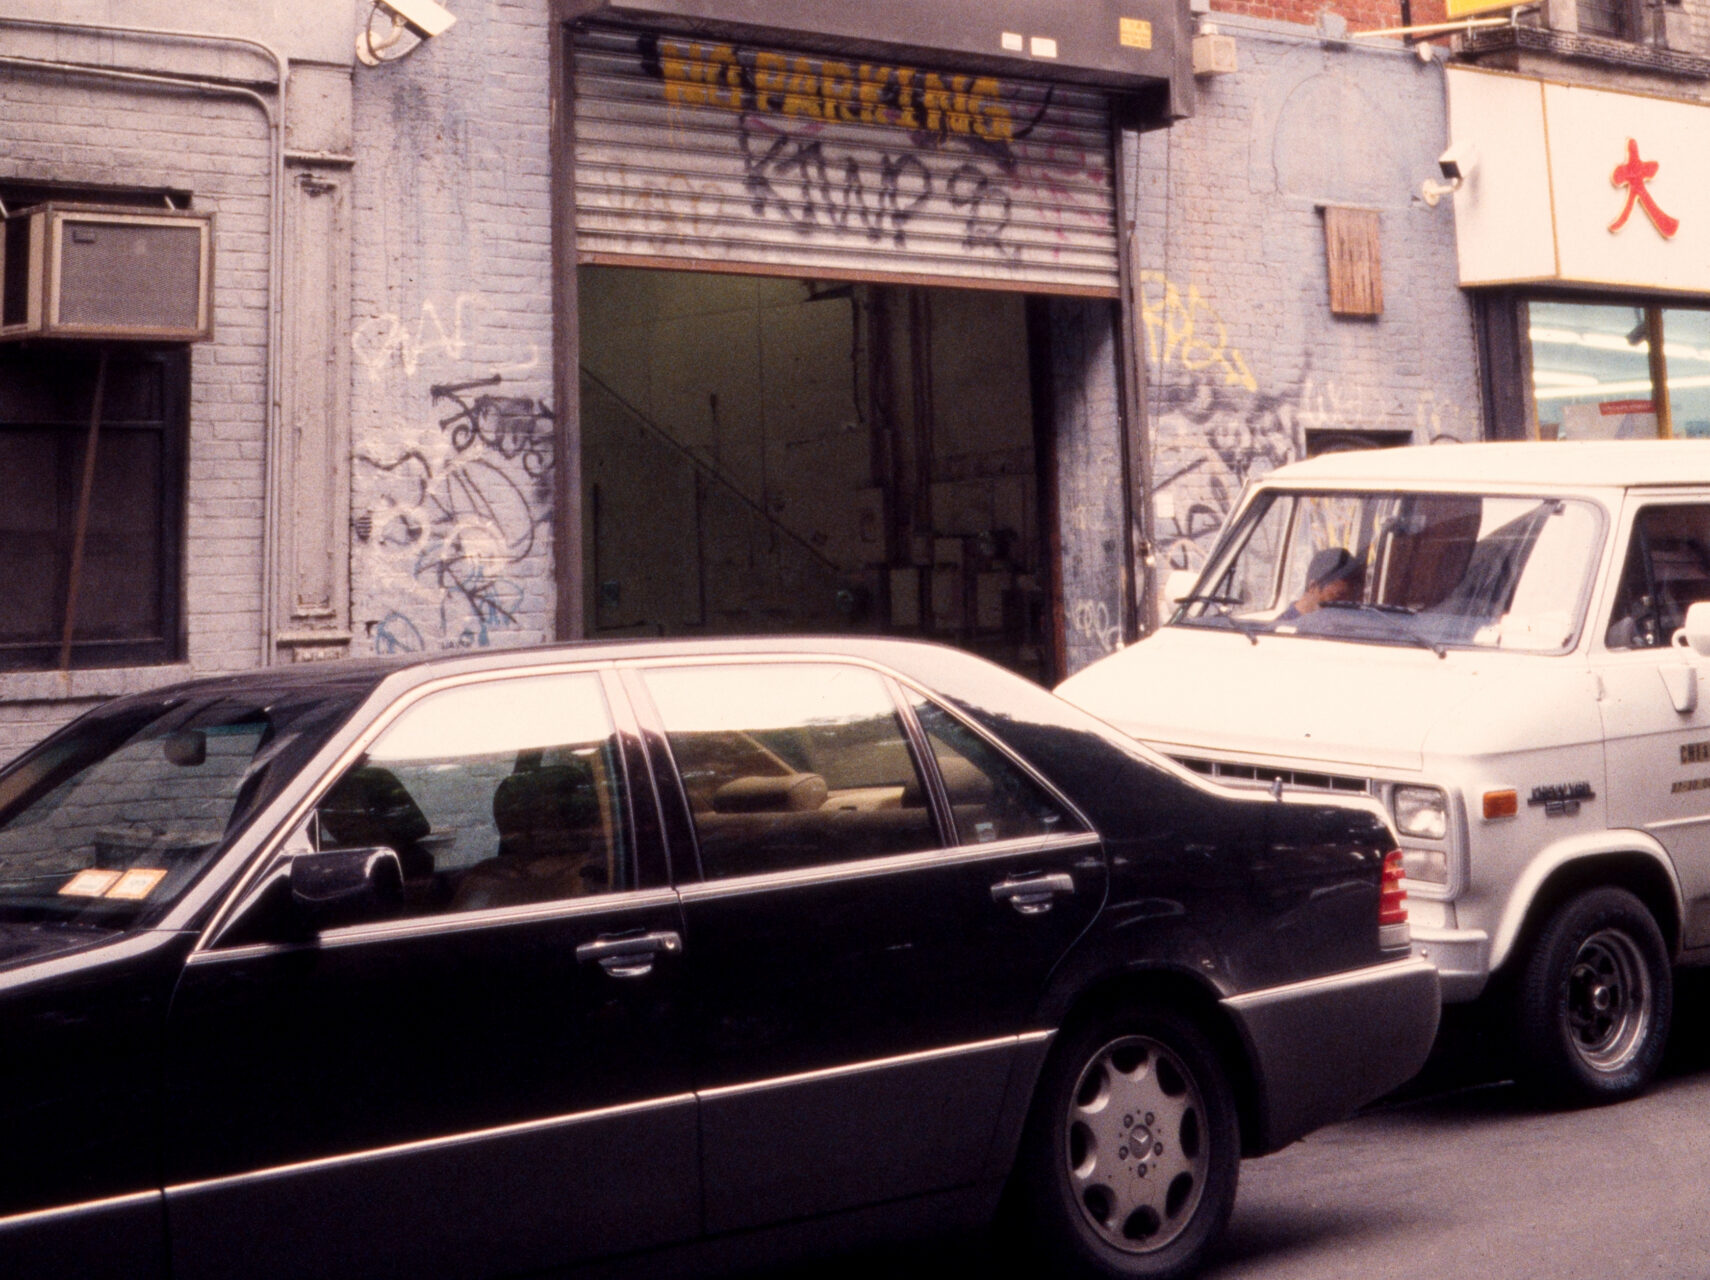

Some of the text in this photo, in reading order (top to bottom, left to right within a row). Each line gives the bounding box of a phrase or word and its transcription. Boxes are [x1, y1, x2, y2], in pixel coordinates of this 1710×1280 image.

[661, 40, 1014, 142] NO PARKING
[1607, 136, 1680, 240] 大
